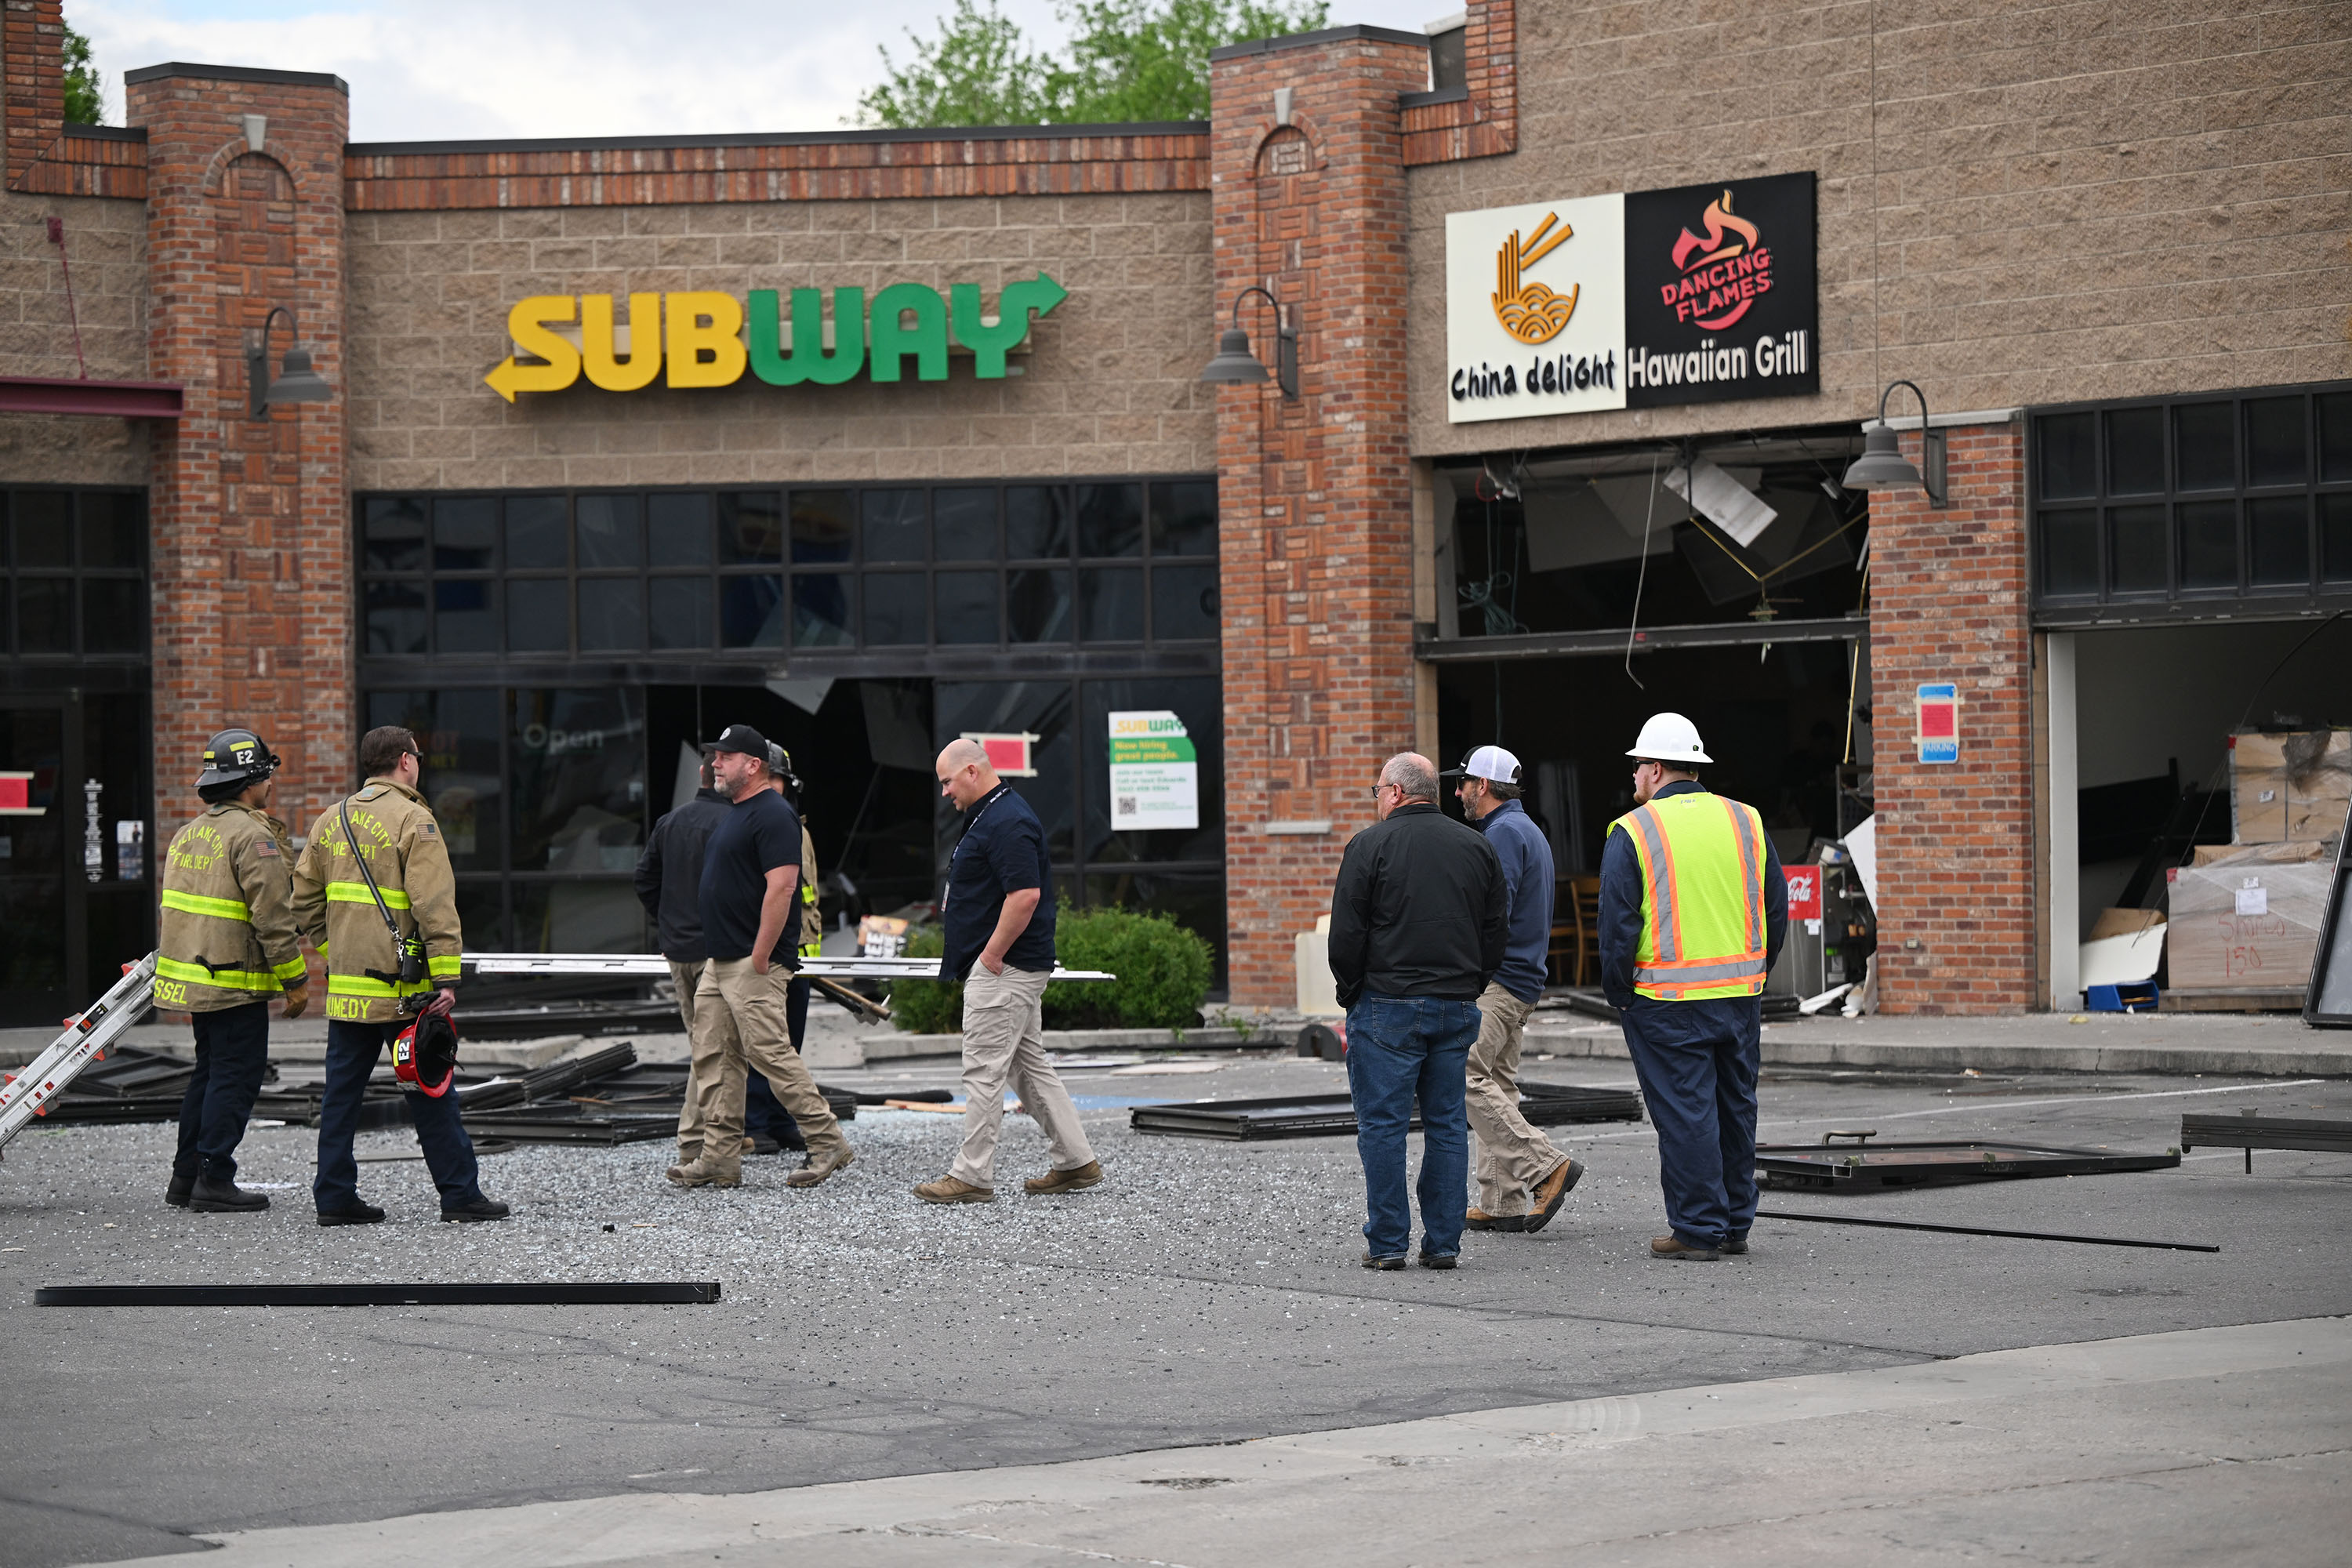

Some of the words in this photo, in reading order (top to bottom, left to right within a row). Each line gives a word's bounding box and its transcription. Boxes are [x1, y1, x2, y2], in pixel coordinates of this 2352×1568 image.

[1661, 248, 1771, 306] DANCING
[1675, 270, 1773, 323] FLAMES
[484, 270, 1069, 404] SUBWAY
[1628, 338, 1750, 389] Hawaiian
[1755, 329, 1807, 378] Grill
[1451, 361, 1517, 401] China
[1526, 349, 1615, 394] delight
[523, 723, 604, 756] Open
[1116, 719, 1183, 734] SUBWAY
[236, 750, 255, 766] E2
[1115, 741, 1137, 750] Now
[1139, 740, 1167, 752] hiring
[1922, 741, 1955, 753] ARKING
[320, 815, 340, 848] SALT
[350, 810, 374, 829] AKE
[371, 821, 392, 851] CITY
[172, 852, 193, 869] FIRE
[194, 855, 214, 871] DEPT
[211, 834, 224, 860] CITY
[353, 844, 376, 860] EPT
[2226, 946, 2263, 978] 150
[398, 1041, 410, 1061] E2
